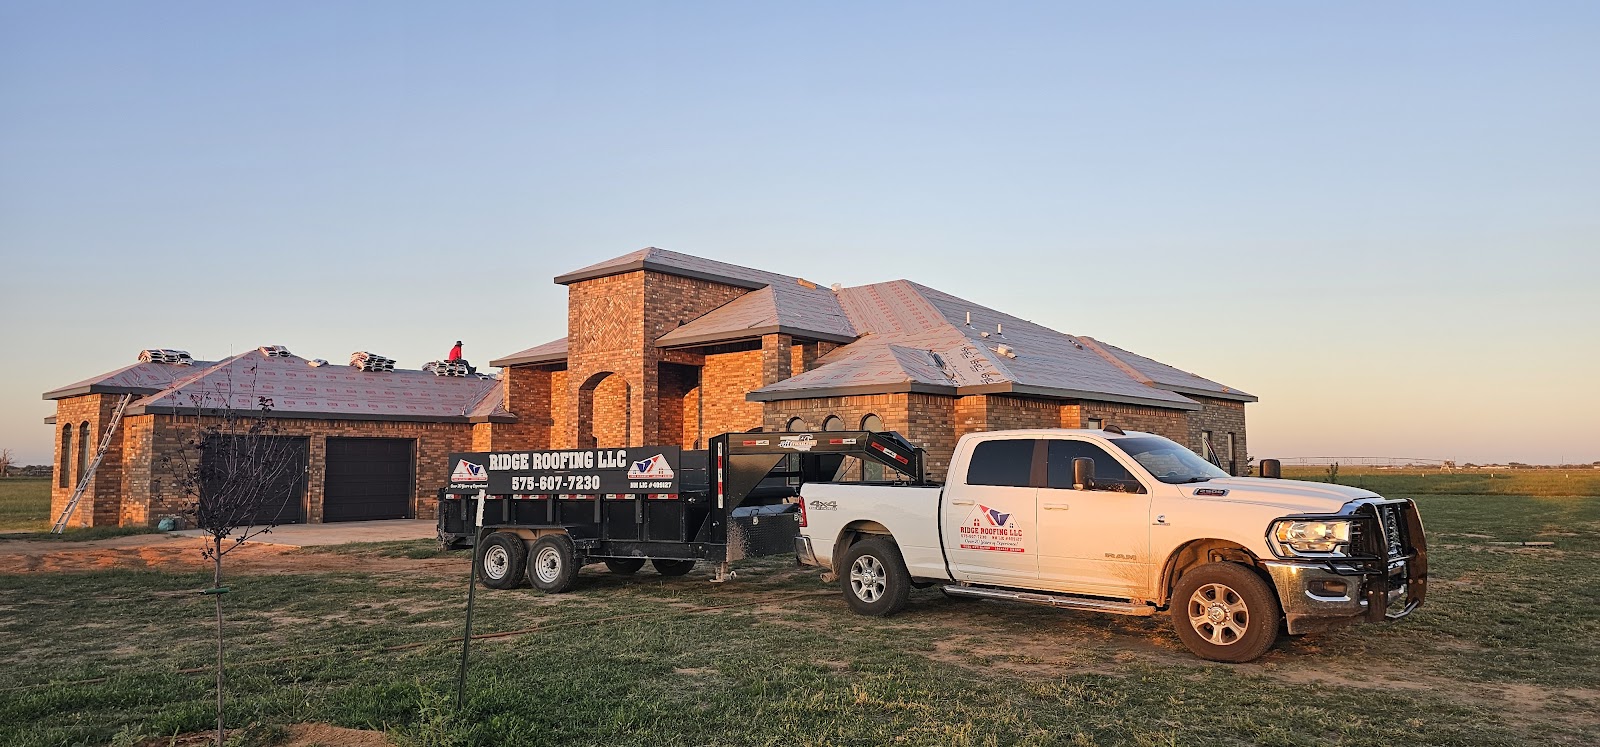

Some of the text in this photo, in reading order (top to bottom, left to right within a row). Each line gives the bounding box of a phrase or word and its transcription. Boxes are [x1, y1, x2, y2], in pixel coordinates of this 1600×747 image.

[489, 449, 627, 471] RIDGE ROOFING LLC
[511, 475, 600, 491] 575-607-7230
[960, 526, 1023, 537] RIDGE ROOFING LLC
[1104, 552, 1137, 561] RAM
